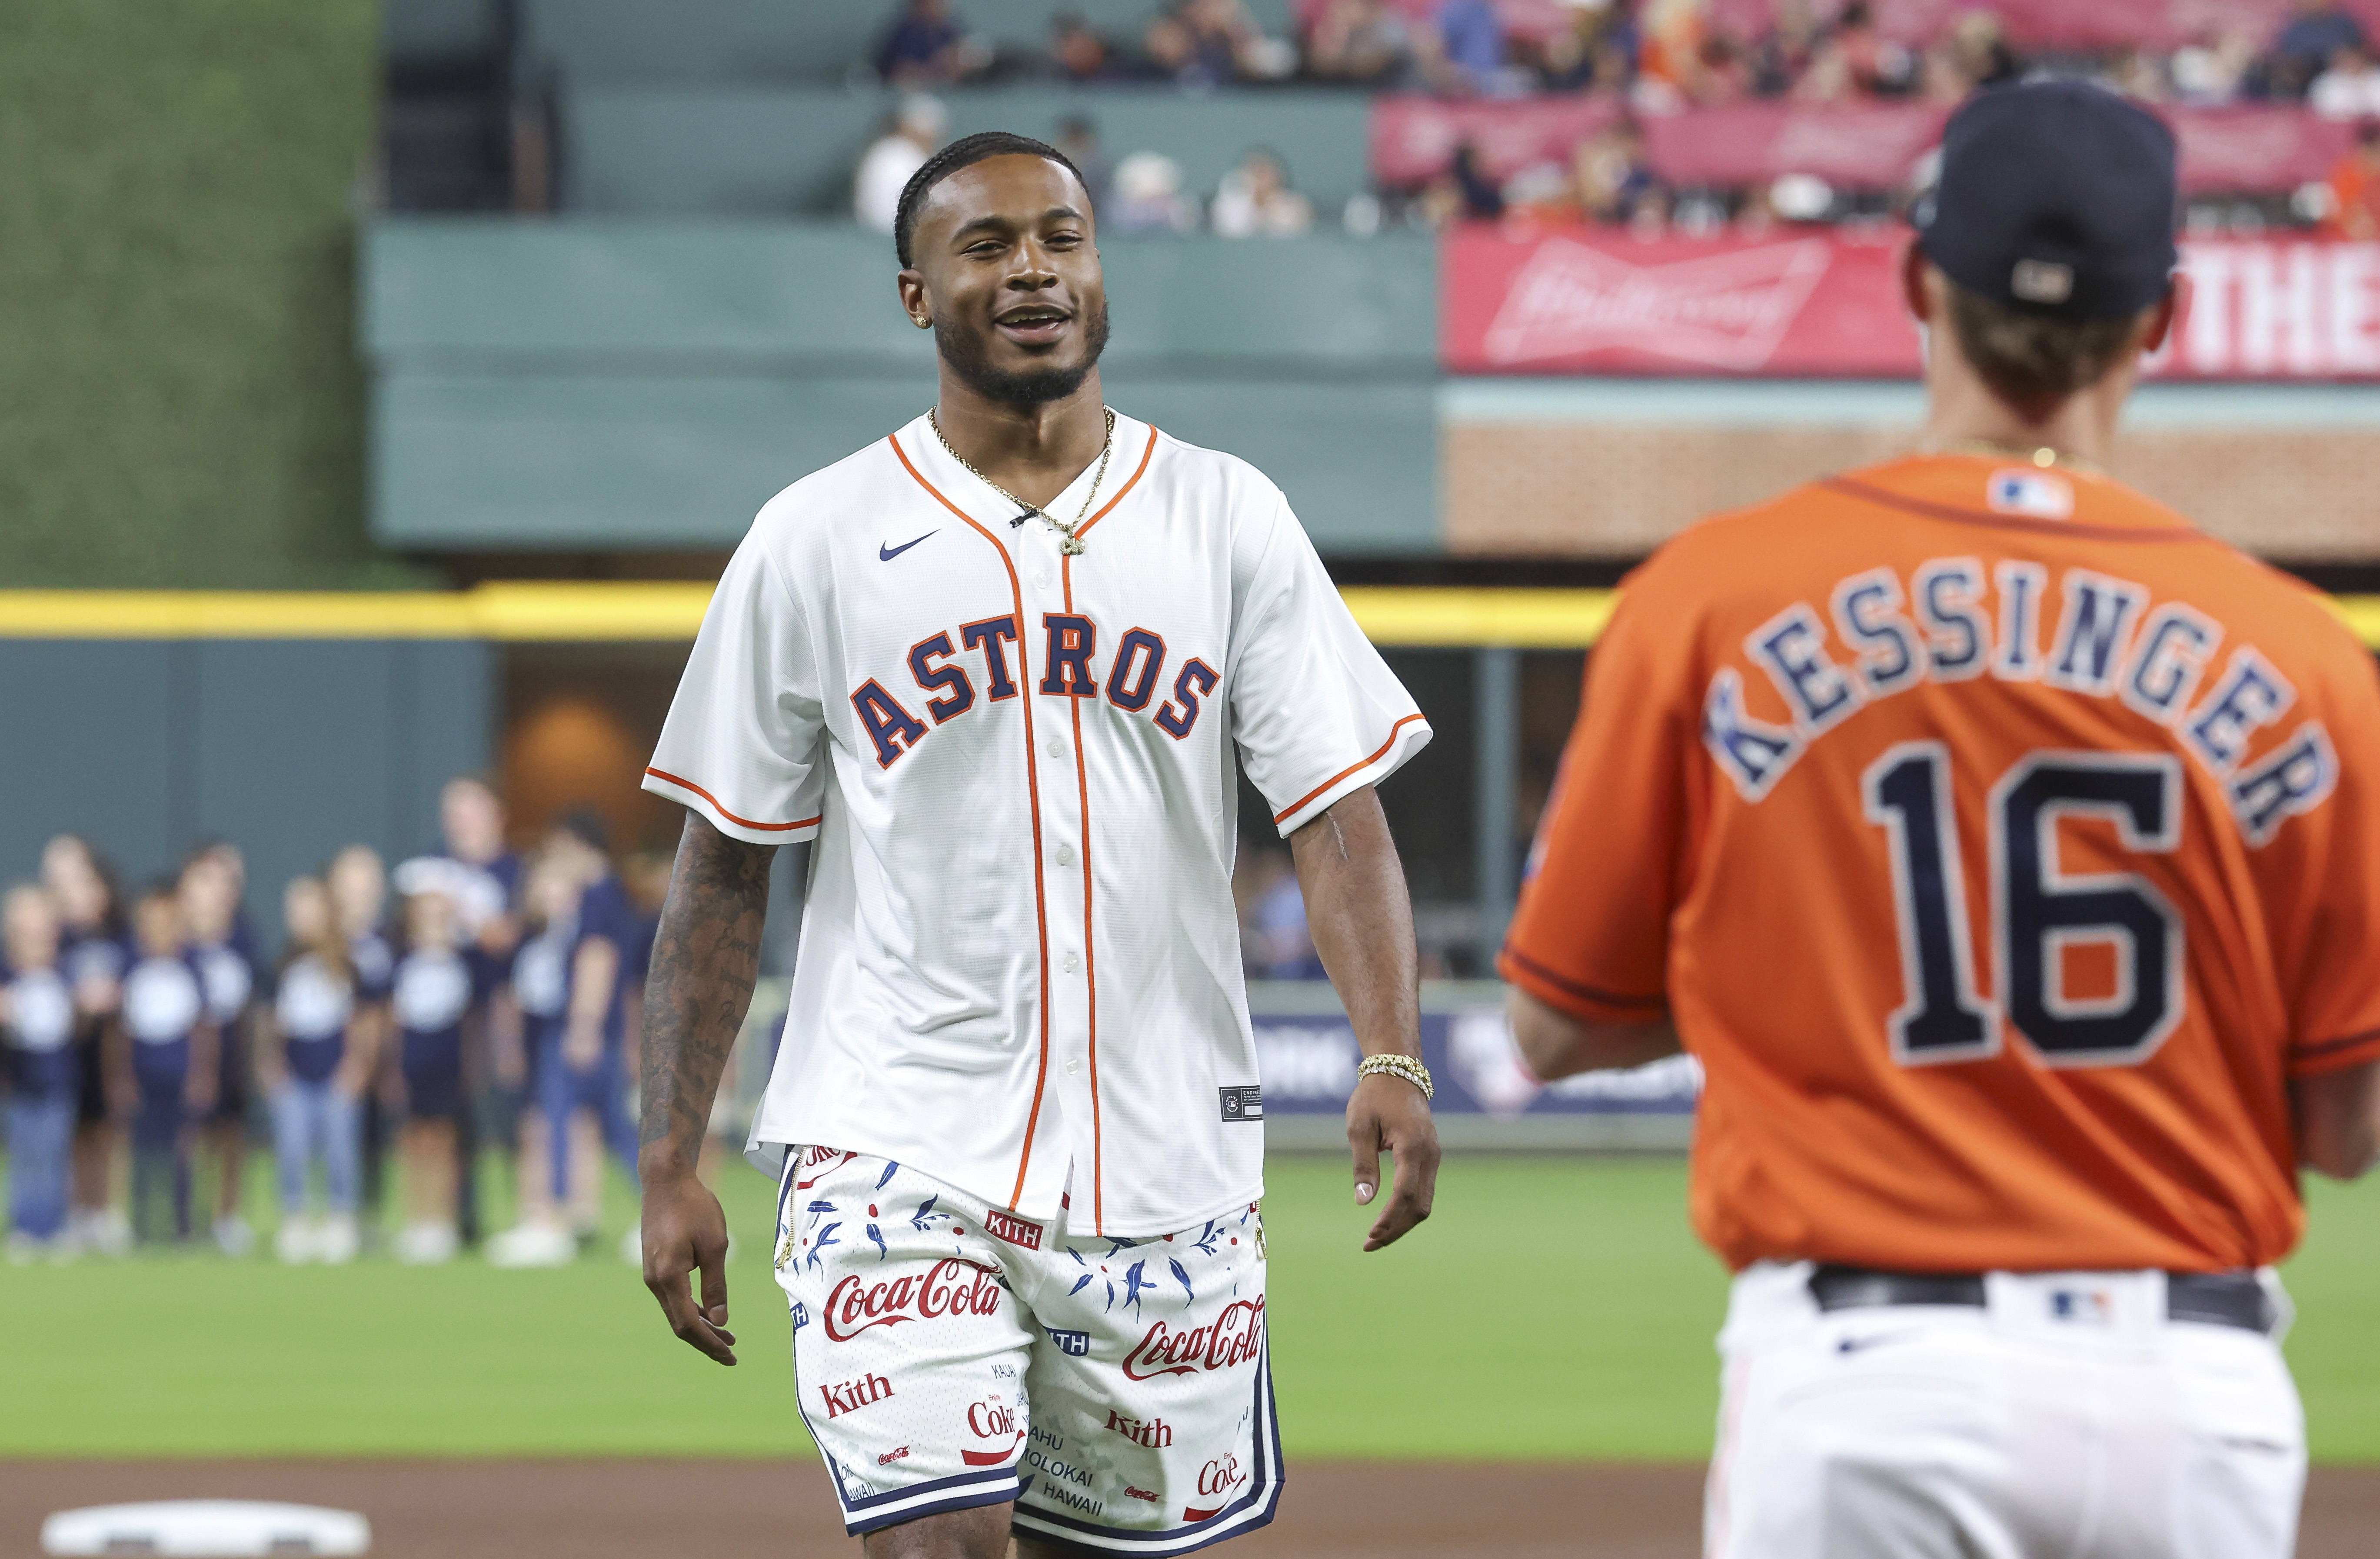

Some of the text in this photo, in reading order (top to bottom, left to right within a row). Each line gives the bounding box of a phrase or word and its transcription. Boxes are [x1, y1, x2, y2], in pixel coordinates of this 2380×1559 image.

[850, 612, 1221, 770] ASTROS
[1700, 556, 2340, 848] KESSINGER
[1861, 735, 2186, 1067] 16
[988, 1215, 1039, 1247] KITH
[790, 1305, 807, 1328] TH
[823, 1257, 1002, 1342] Coca-Cola
[1122, 1293, 1265, 1381] Coca-Cola
[819, 1372, 895, 1419] Kith
[967, 1401, 1015, 1438] Coke
[1028, 1426, 1064, 1450] AHU
[1103, 1409, 1172, 1448] Kith
[878, 1445, 909, 1466] Coca-Cola
[1043, 1482, 1103, 1516] HAWAII
